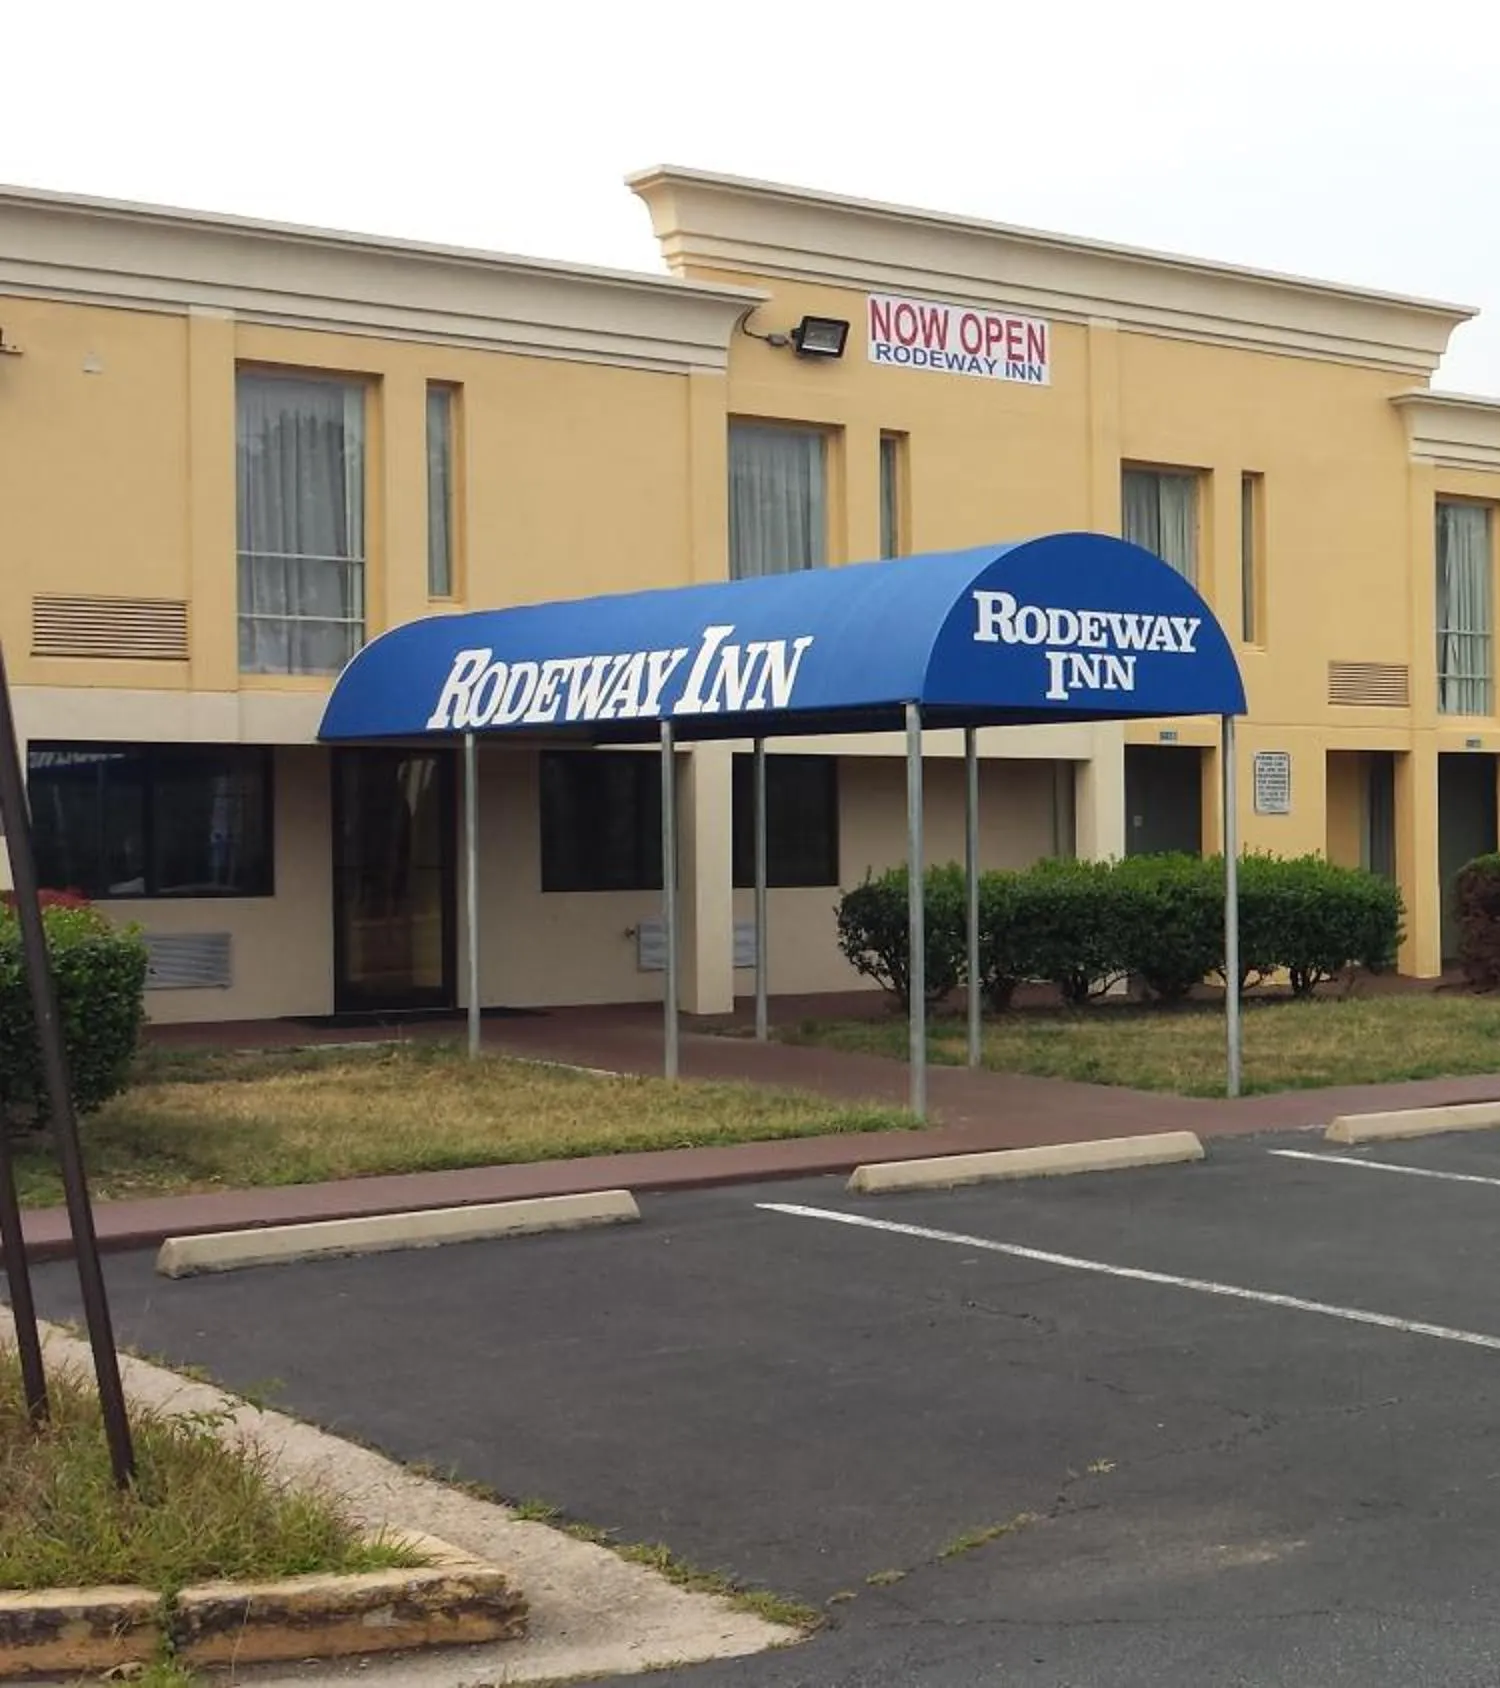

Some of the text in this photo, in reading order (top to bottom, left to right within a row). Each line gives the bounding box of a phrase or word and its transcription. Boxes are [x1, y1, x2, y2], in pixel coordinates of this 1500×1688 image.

[870, 299, 1046, 365] NOW OPEN
[875, 342, 1042, 382] RODEWAY INN
[973, 590, 1201, 653] RODEWAY
[426, 624, 814, 729] RODEWAY INN
[1045, 651, 1136, 700] INN
